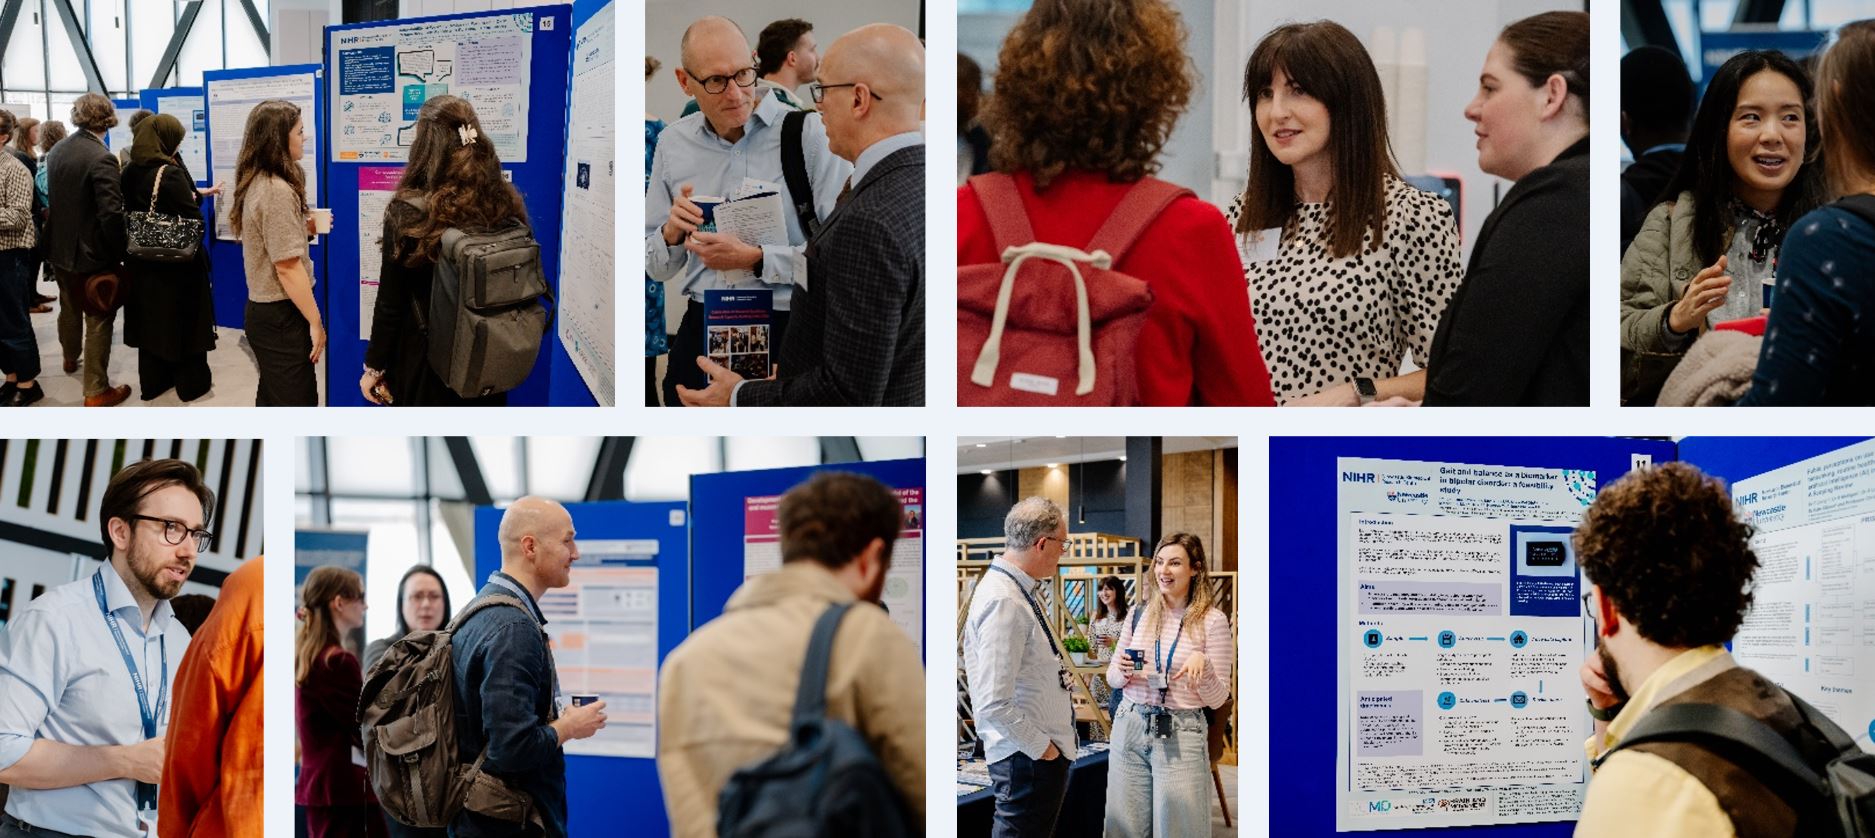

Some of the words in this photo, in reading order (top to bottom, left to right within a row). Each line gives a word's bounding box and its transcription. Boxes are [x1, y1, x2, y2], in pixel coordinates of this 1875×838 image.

[341, 36, 359, 44] NHR
[1342, 471, 1376, 484] NIHR
[1736, 492, 1758, 506] NIHR
[105, 612, 118, 629] NIHR
[132, 672, 143, 691] NIHR
